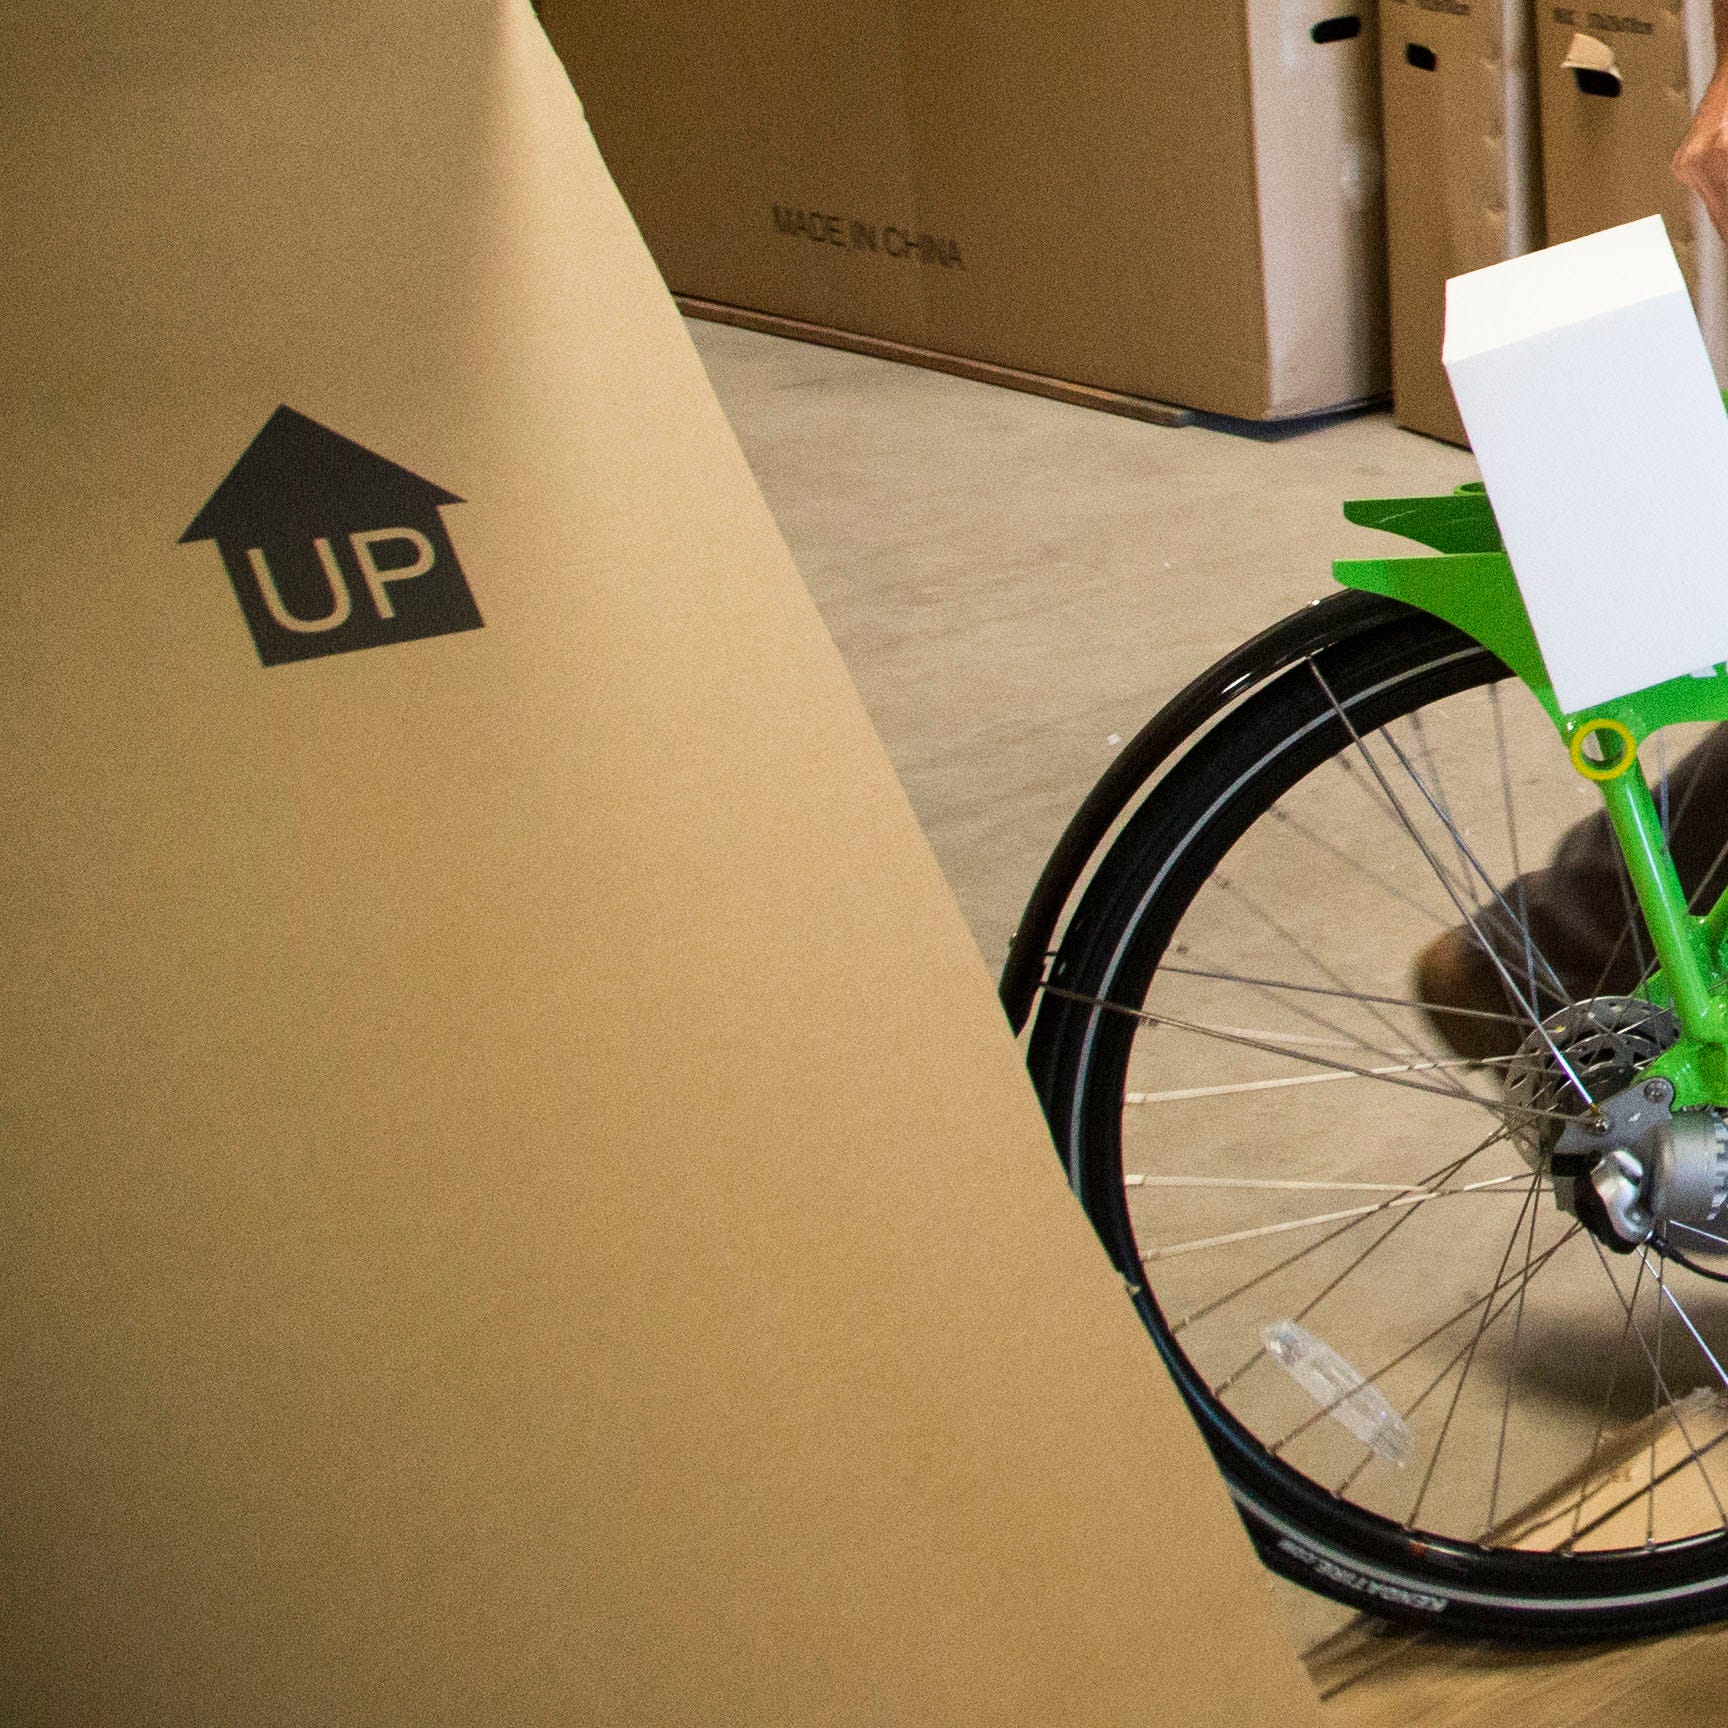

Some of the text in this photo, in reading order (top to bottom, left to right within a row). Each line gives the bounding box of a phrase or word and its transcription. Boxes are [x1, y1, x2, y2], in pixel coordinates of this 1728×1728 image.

[772, 202, 966, 269] MADE IN CHINA
[246, 525, 435, 634] UP
